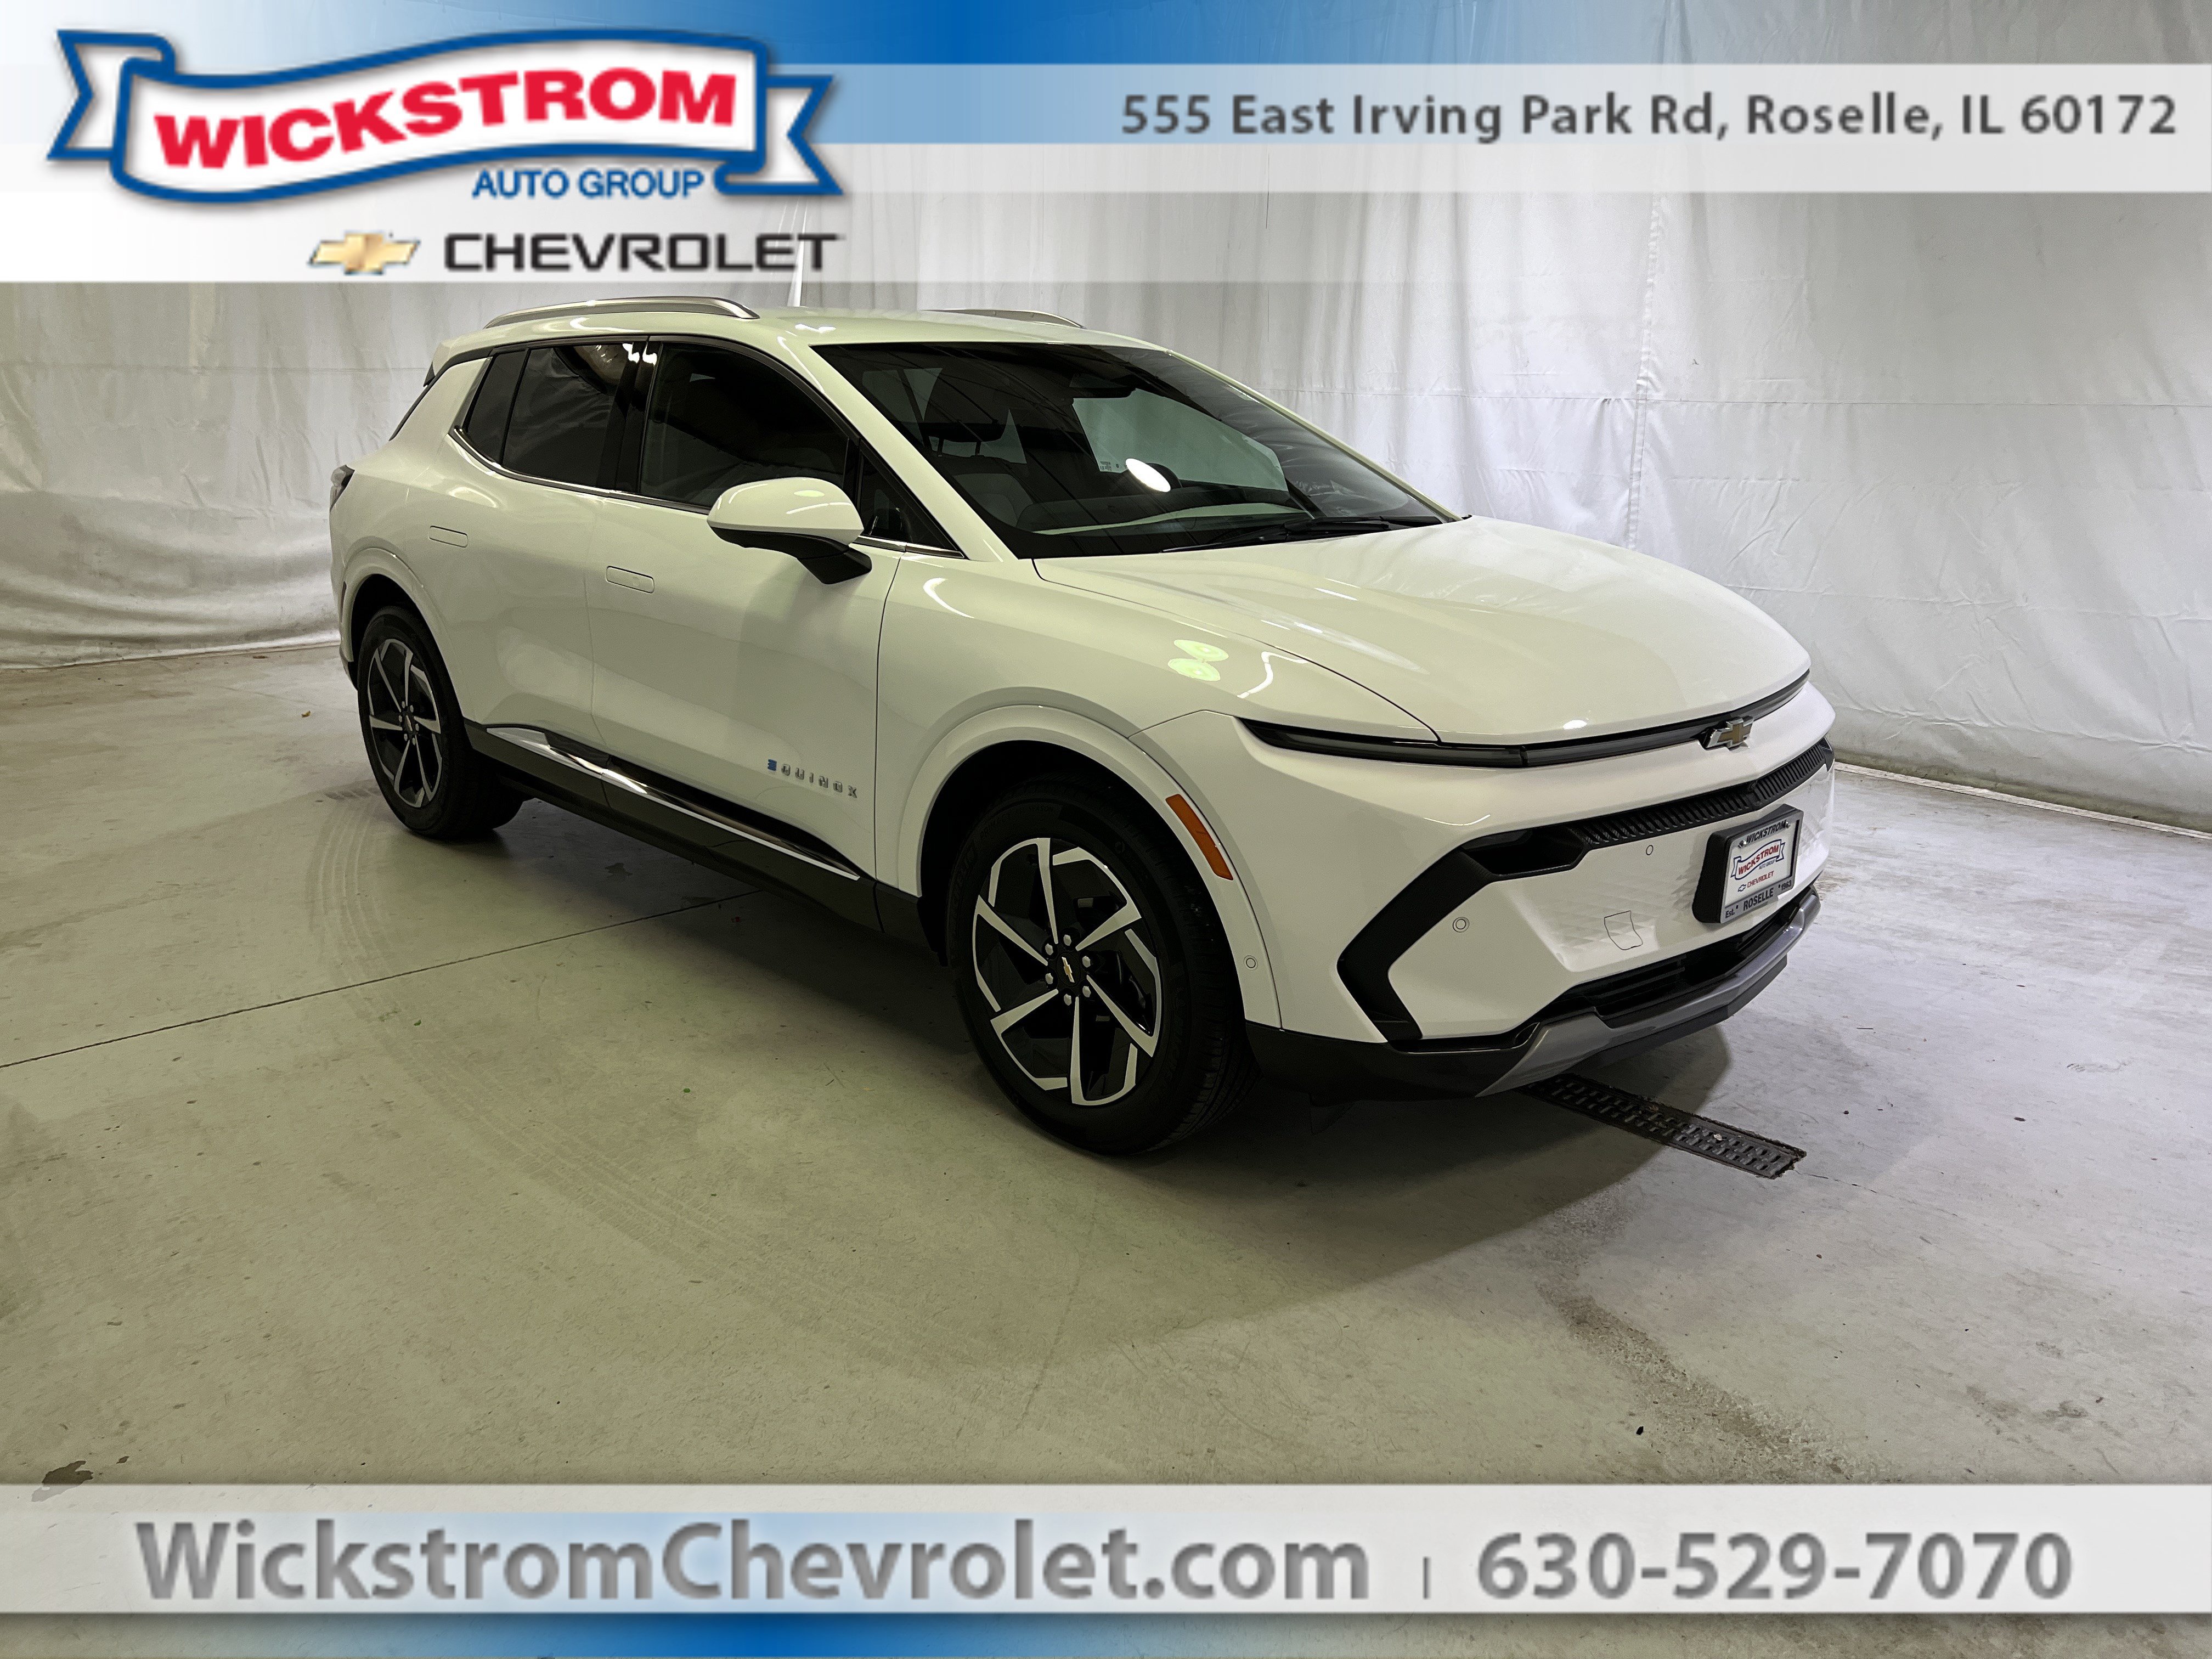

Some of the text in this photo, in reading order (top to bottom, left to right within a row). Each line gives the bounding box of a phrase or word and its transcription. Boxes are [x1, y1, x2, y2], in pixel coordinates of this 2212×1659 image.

[768, 759, 857, 798] EQUINOX
[1746, 820, 1787, 844] WICKSTROM
[1738, 844, 1779, 875] WICKSTROM
[1743, 888, 1774, 911] ROSELLE
[1781, 879, 1792, 890] 1963
[1747, 871, 1774, 888] CHEVROLET
